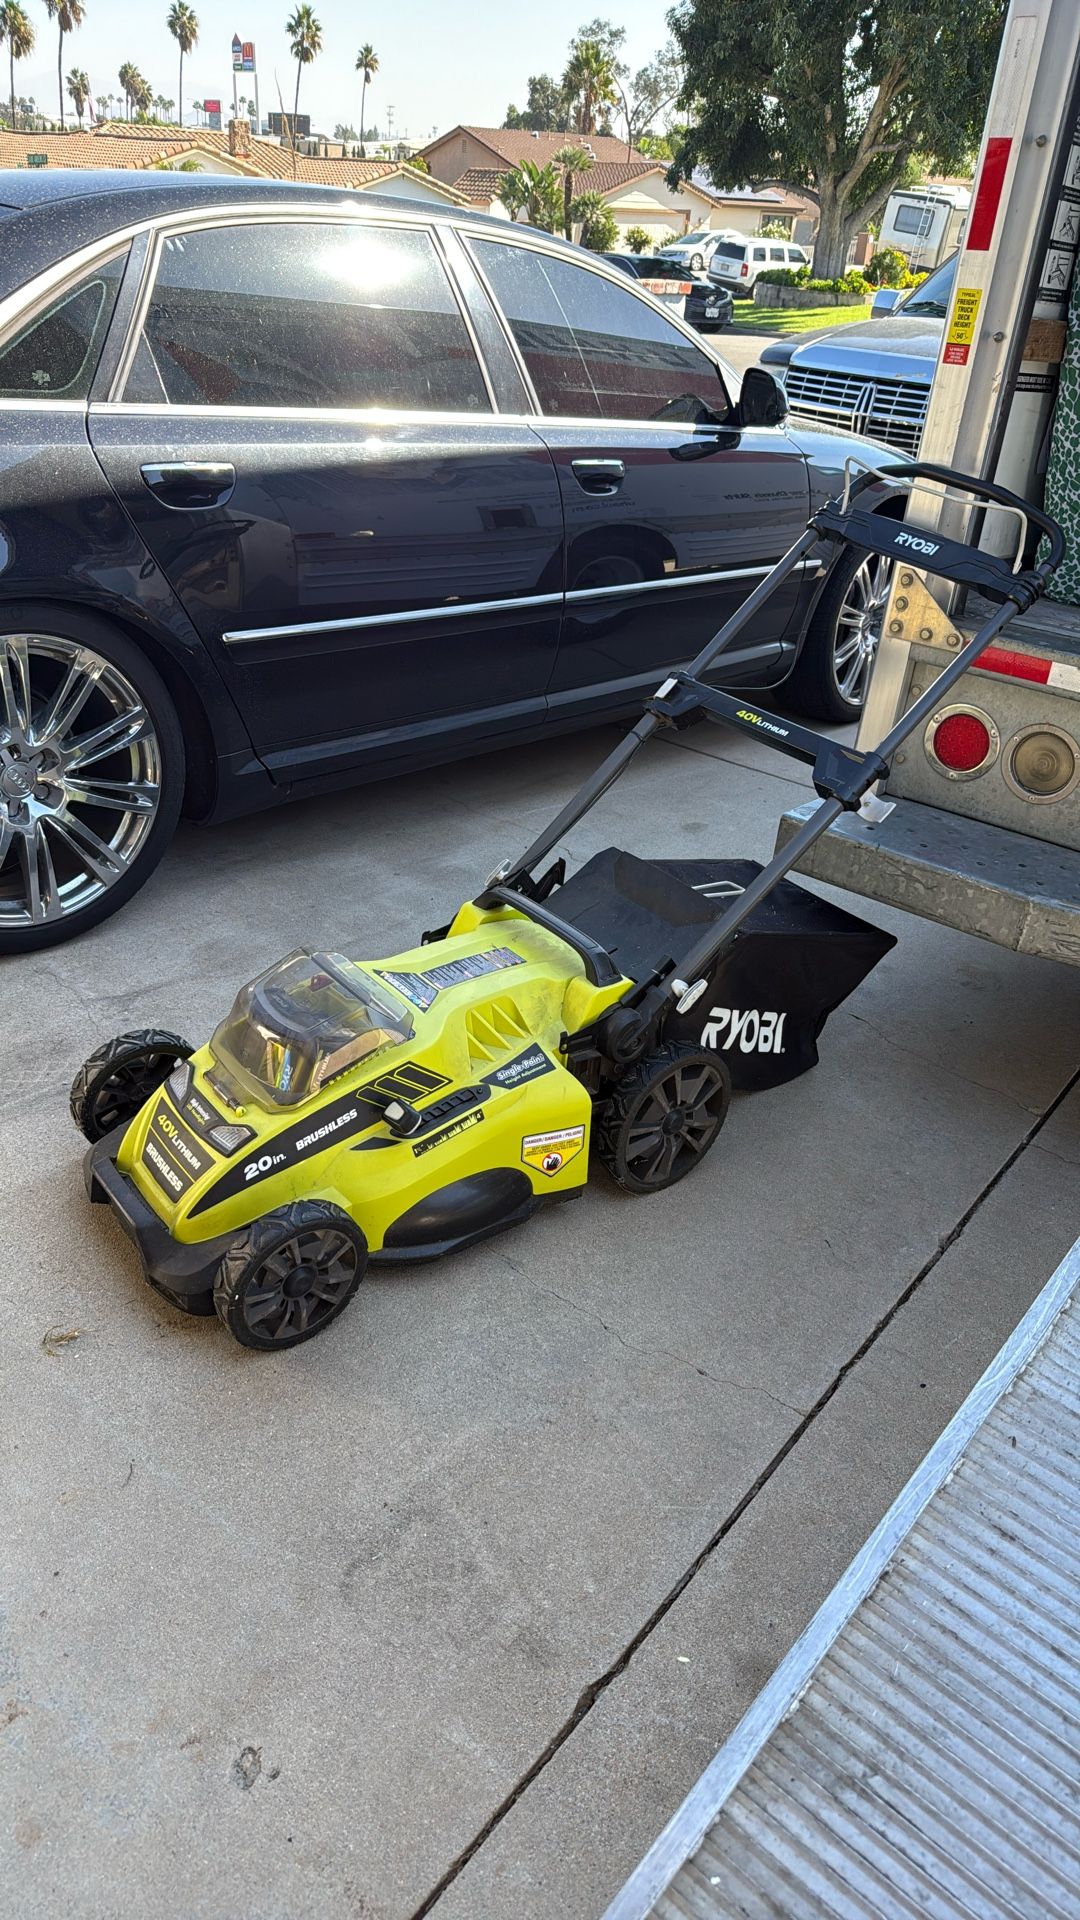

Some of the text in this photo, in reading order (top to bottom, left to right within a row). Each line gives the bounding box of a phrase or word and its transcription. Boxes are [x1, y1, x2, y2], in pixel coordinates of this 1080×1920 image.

[894, 532, 940, 556] RYOBI
[700, 1007, 787, 1054] RYOBI
[295, 1109, 358, 1151] BRUSHLESS
[525, 1137, 542, 1145] DANGER
[146, 1142, 183, 1192] BRUSHLESS
